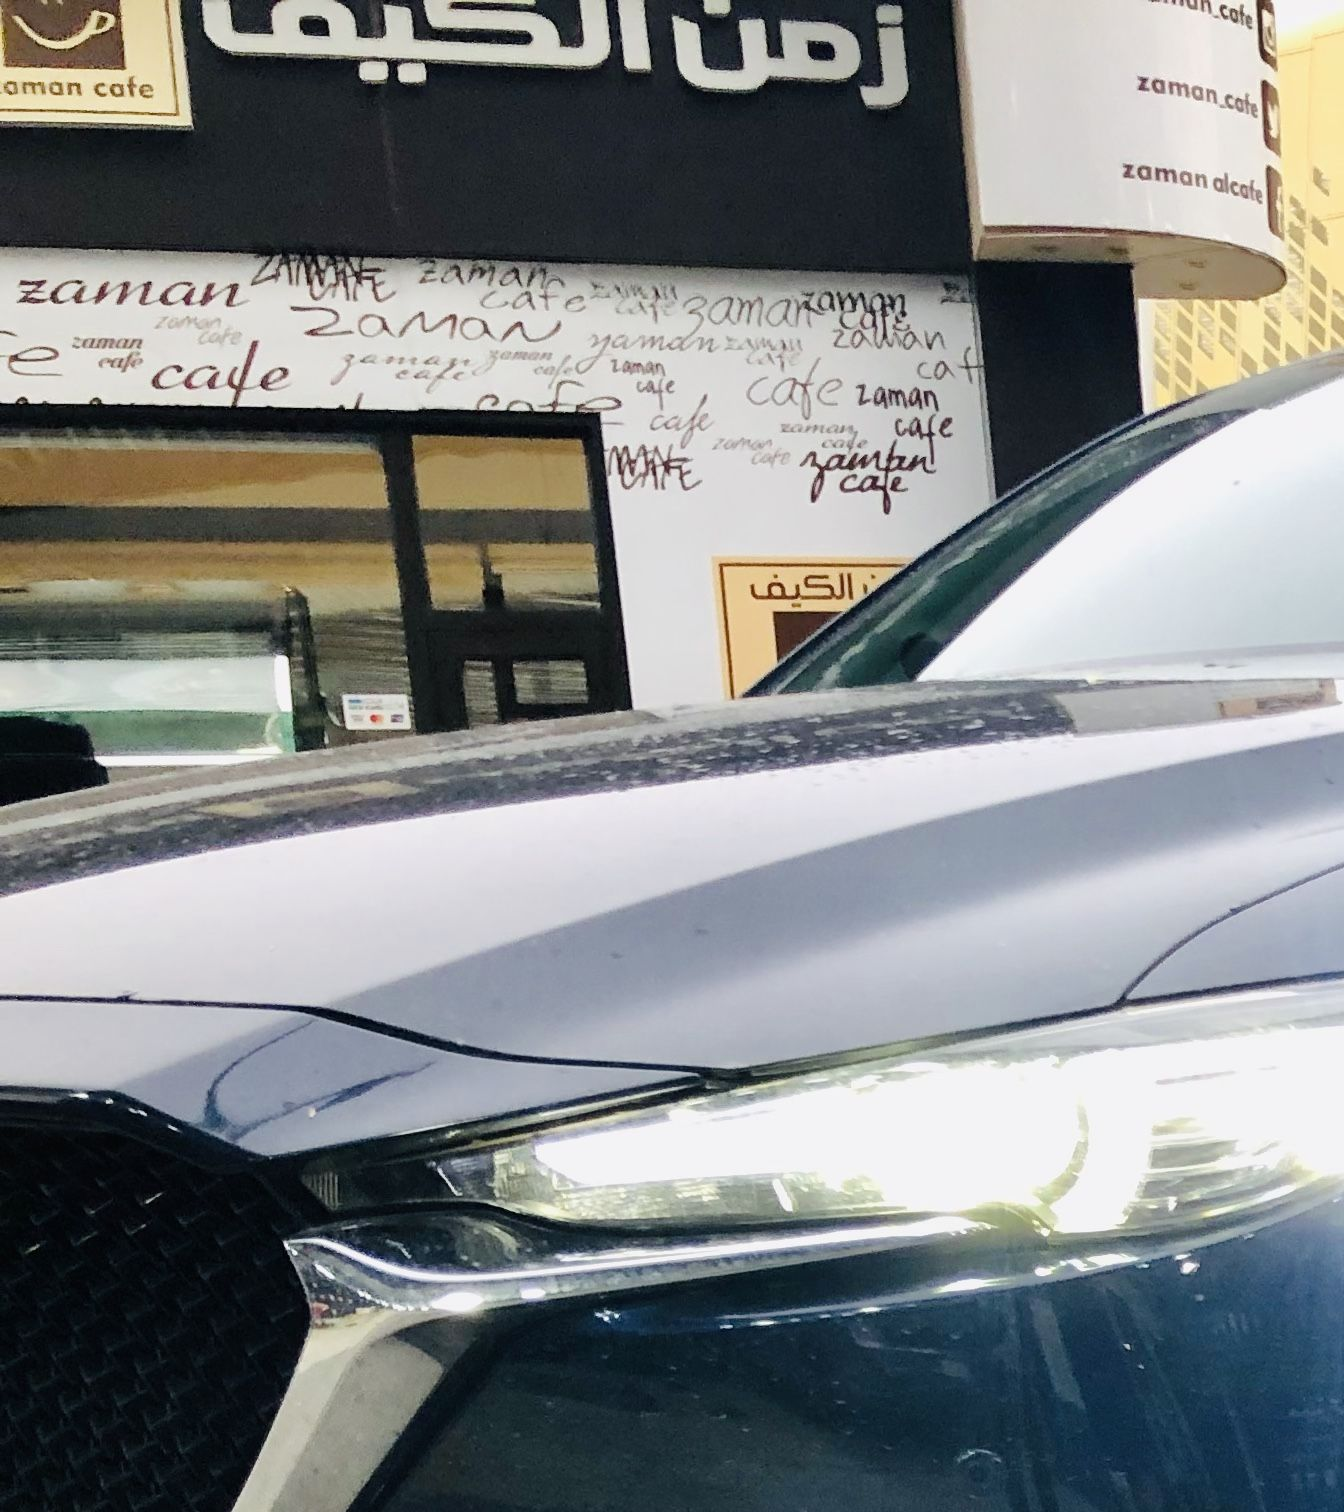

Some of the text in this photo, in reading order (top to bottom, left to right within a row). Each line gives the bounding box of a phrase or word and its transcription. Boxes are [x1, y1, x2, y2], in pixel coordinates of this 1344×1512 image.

[672, 0, 909, 110] زمن
[0, 76, 155, 99] aman cafe
[1137, 76, 1259, 118] zaman_cafe
[1123, 163, 1263, 205] zaman alcafe
[16, 279, 250, 307] zaman
[72, 337, 144, 349] zaman
[98, 352, 144, 373] cafe
[152, 340, 292, 408] cafe
[611, 358, 666, 376] zaman
[917, 346, 985, 384] caf
[637, 379, 676, 410] cafe
[747, 356, 843, 420] cafe
[857, 384, 938, 411] zaman
[894, 415, 954, 465] cafe
[750, 573, 854, 608] الكيف
